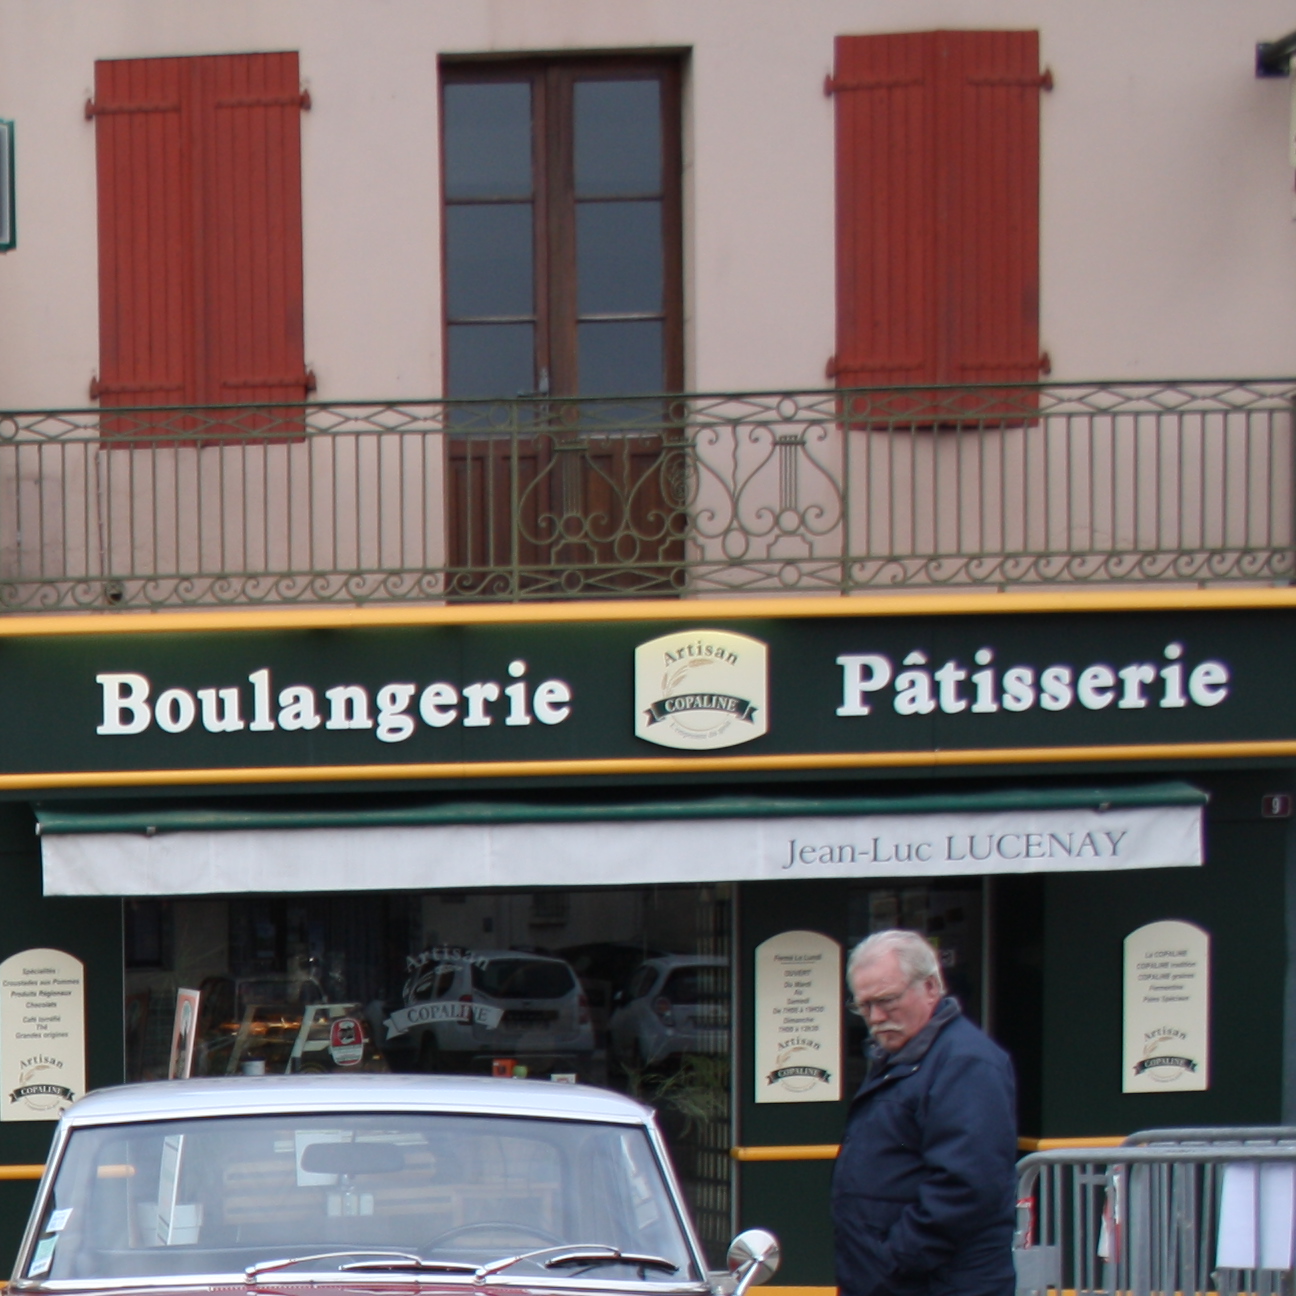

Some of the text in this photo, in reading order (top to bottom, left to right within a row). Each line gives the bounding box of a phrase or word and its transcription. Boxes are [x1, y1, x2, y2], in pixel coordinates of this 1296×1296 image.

[663, 640, 739, 667] Artisan
[835, 641, 1228, 717] Pâtisserie
[95, 659, 572, 743] Boulangerie
[664, 695, 736, 713] COPALINE
[1271, 797, 1280, 815] 9
[782, 830, 1129, 870] Jean-Luc LUCENAY
[406, 944, 489, 972] Artisan
[408, 1004, 488, 1023] COPALINE
[43, 1031, 69, 1039] origines
[1144, 1026, 1186, 1042] Artisan
[777, 1037, 821, 1051] Artisan
[20, 1053, 64, 1070] Artisan
[20, 1086, 63, 1096] COPALINE
